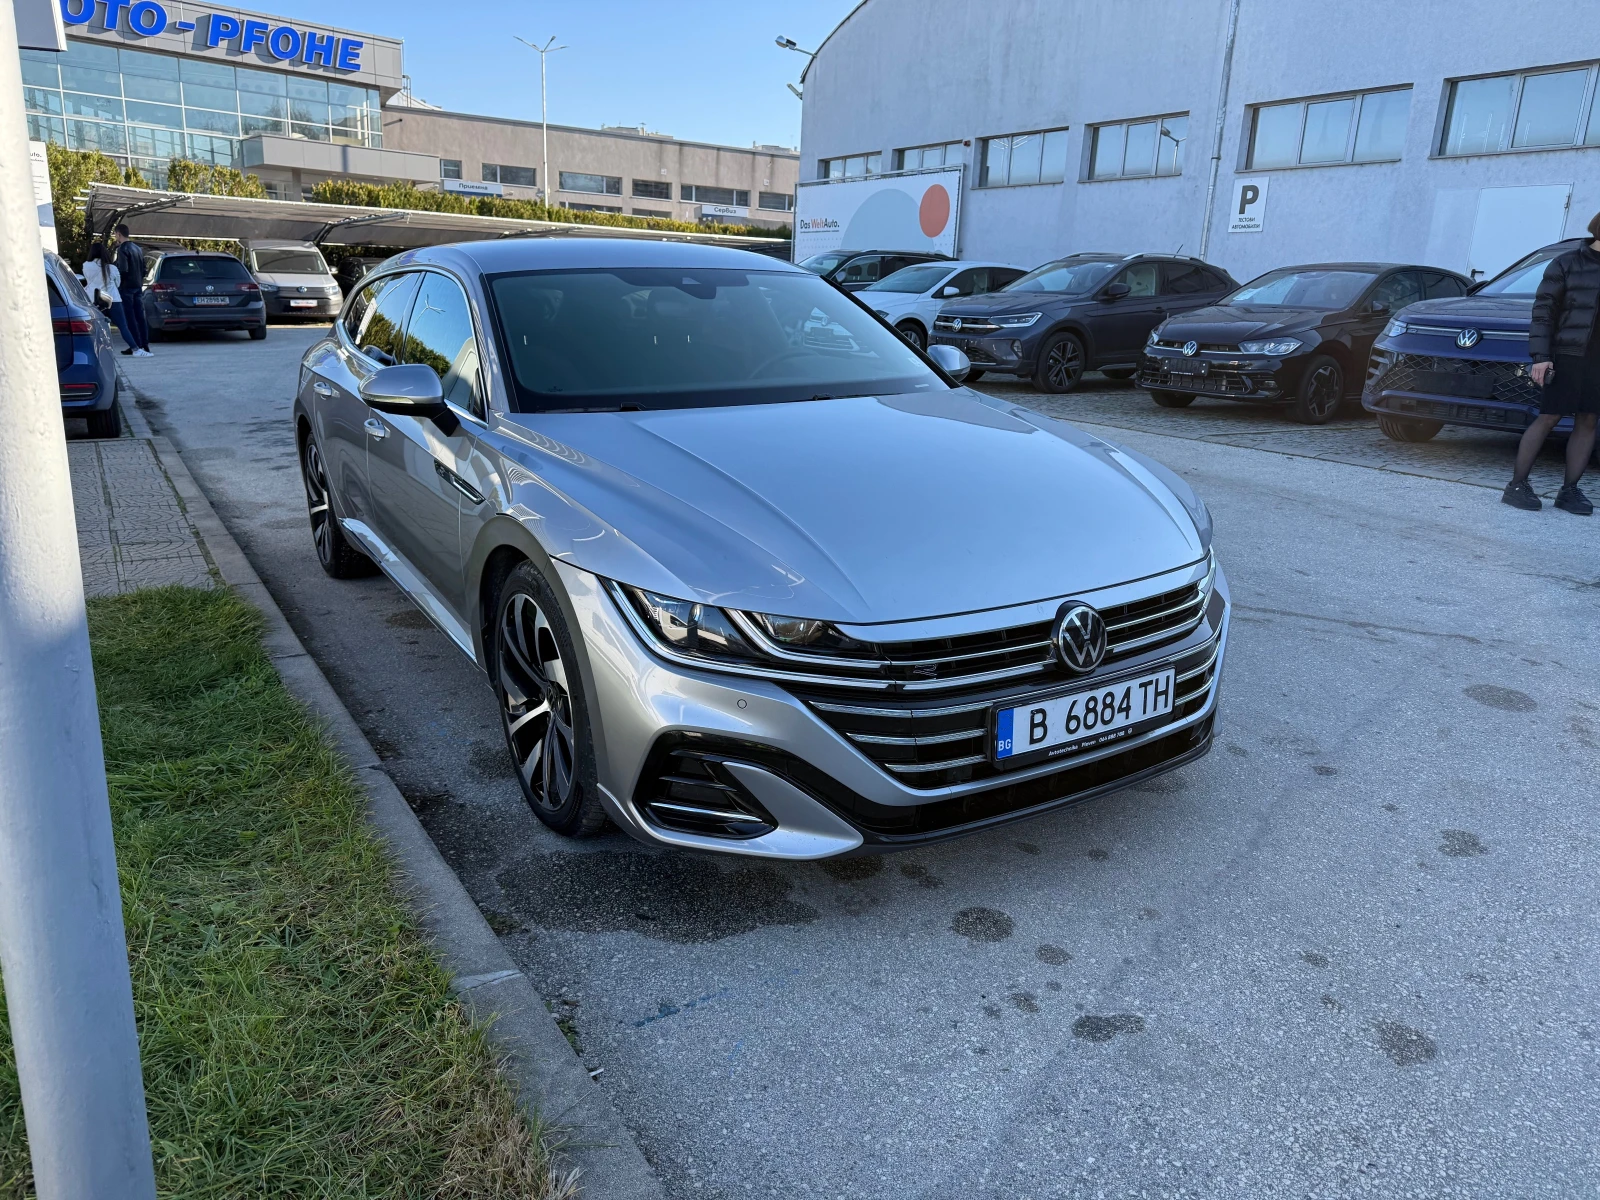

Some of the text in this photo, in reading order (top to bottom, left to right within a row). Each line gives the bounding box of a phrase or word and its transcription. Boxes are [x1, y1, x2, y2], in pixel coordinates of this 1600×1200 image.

[207, 13, 364, 71] PFOHE
[458, 183, 488, 191] Приемна
[1239, 184, 1260, 215] P
[800, 219, 811, 229] Das
[1029, 674, 1170, 745] B 6884 TH
[998, 738, 1012, 751] BG
